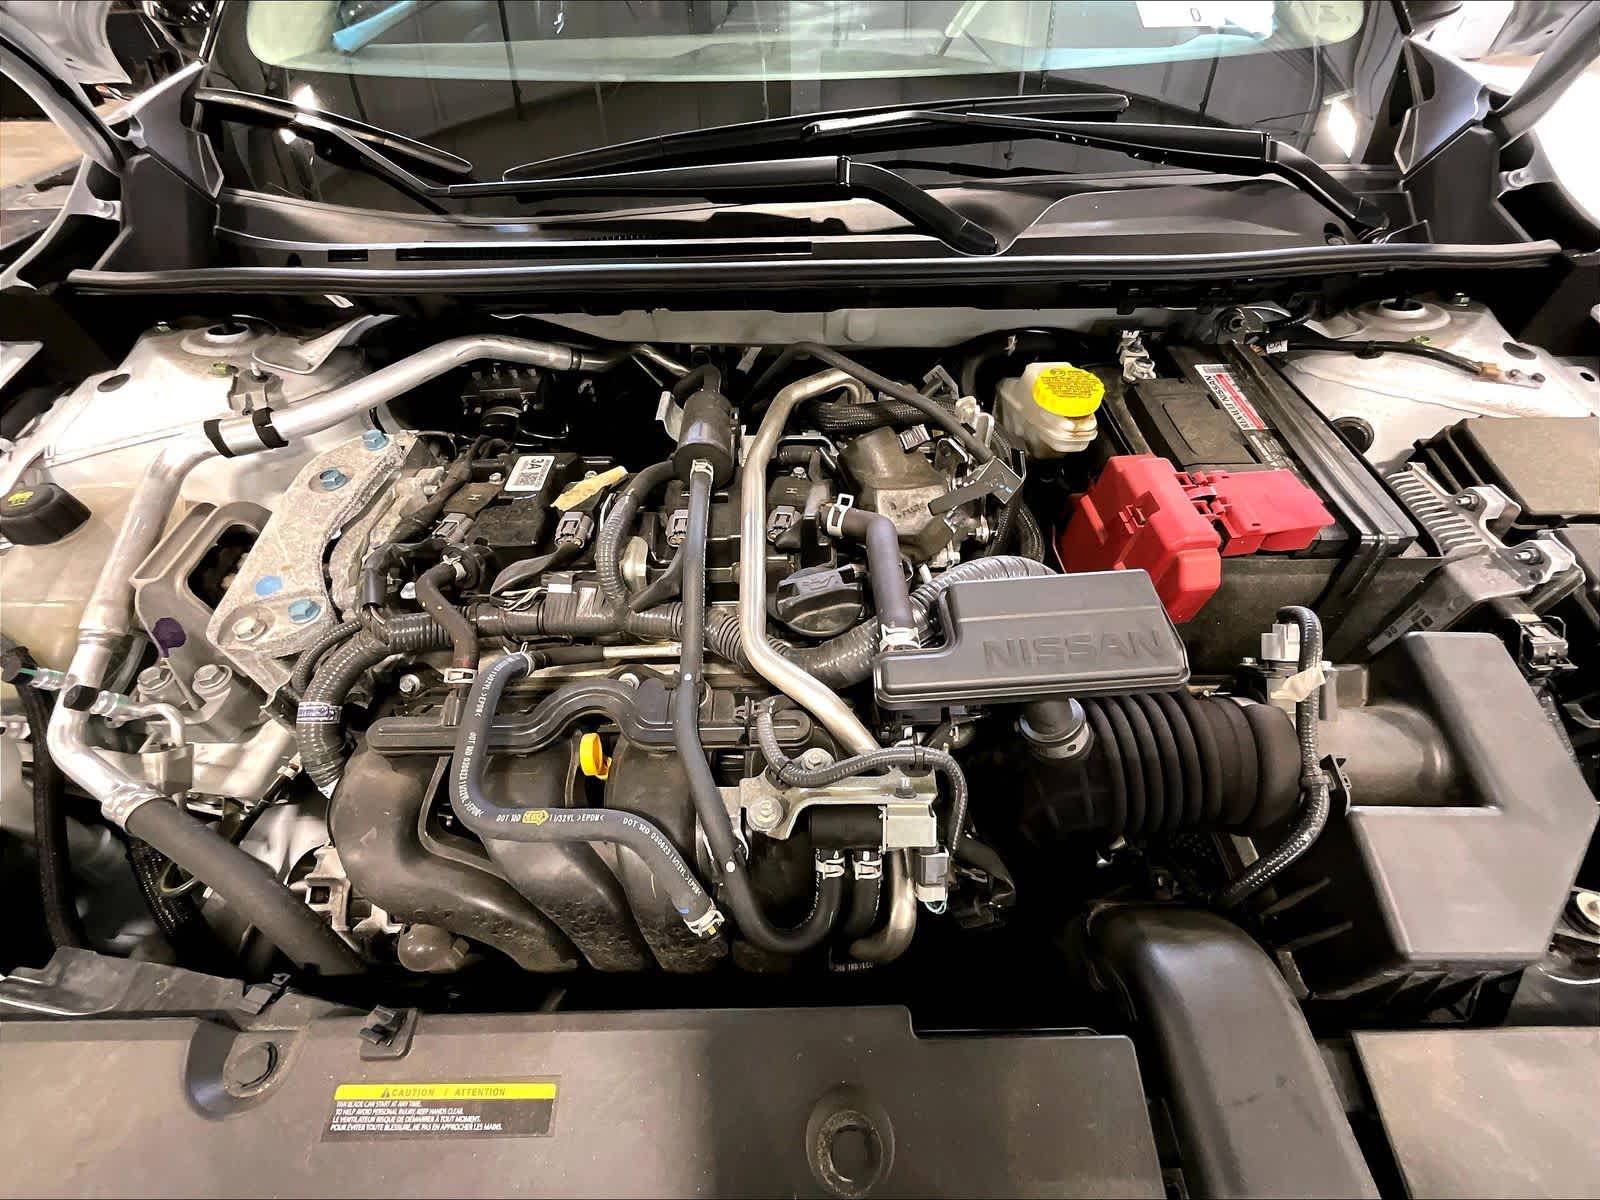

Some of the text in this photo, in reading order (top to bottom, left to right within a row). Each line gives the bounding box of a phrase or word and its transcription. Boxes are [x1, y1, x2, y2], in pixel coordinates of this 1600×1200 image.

[528, 459, 544, 469] 3A
[982, 629, 1162, 669] NISSAN
[623, 817, 638, 828] DOT
[392, 1088, 435, 1097] CAUTION
[455, 1087, 506, 1097] ATTENTION
[429, 1108, 447, 1116] HANDS
[440, 1115, 455, 1123] TOUT
[330, 1123, 347, 1131] POUR
[366, 1123, 384, 1131] TOUTE
[440, 1123, 473, 1131] APPROCHER
